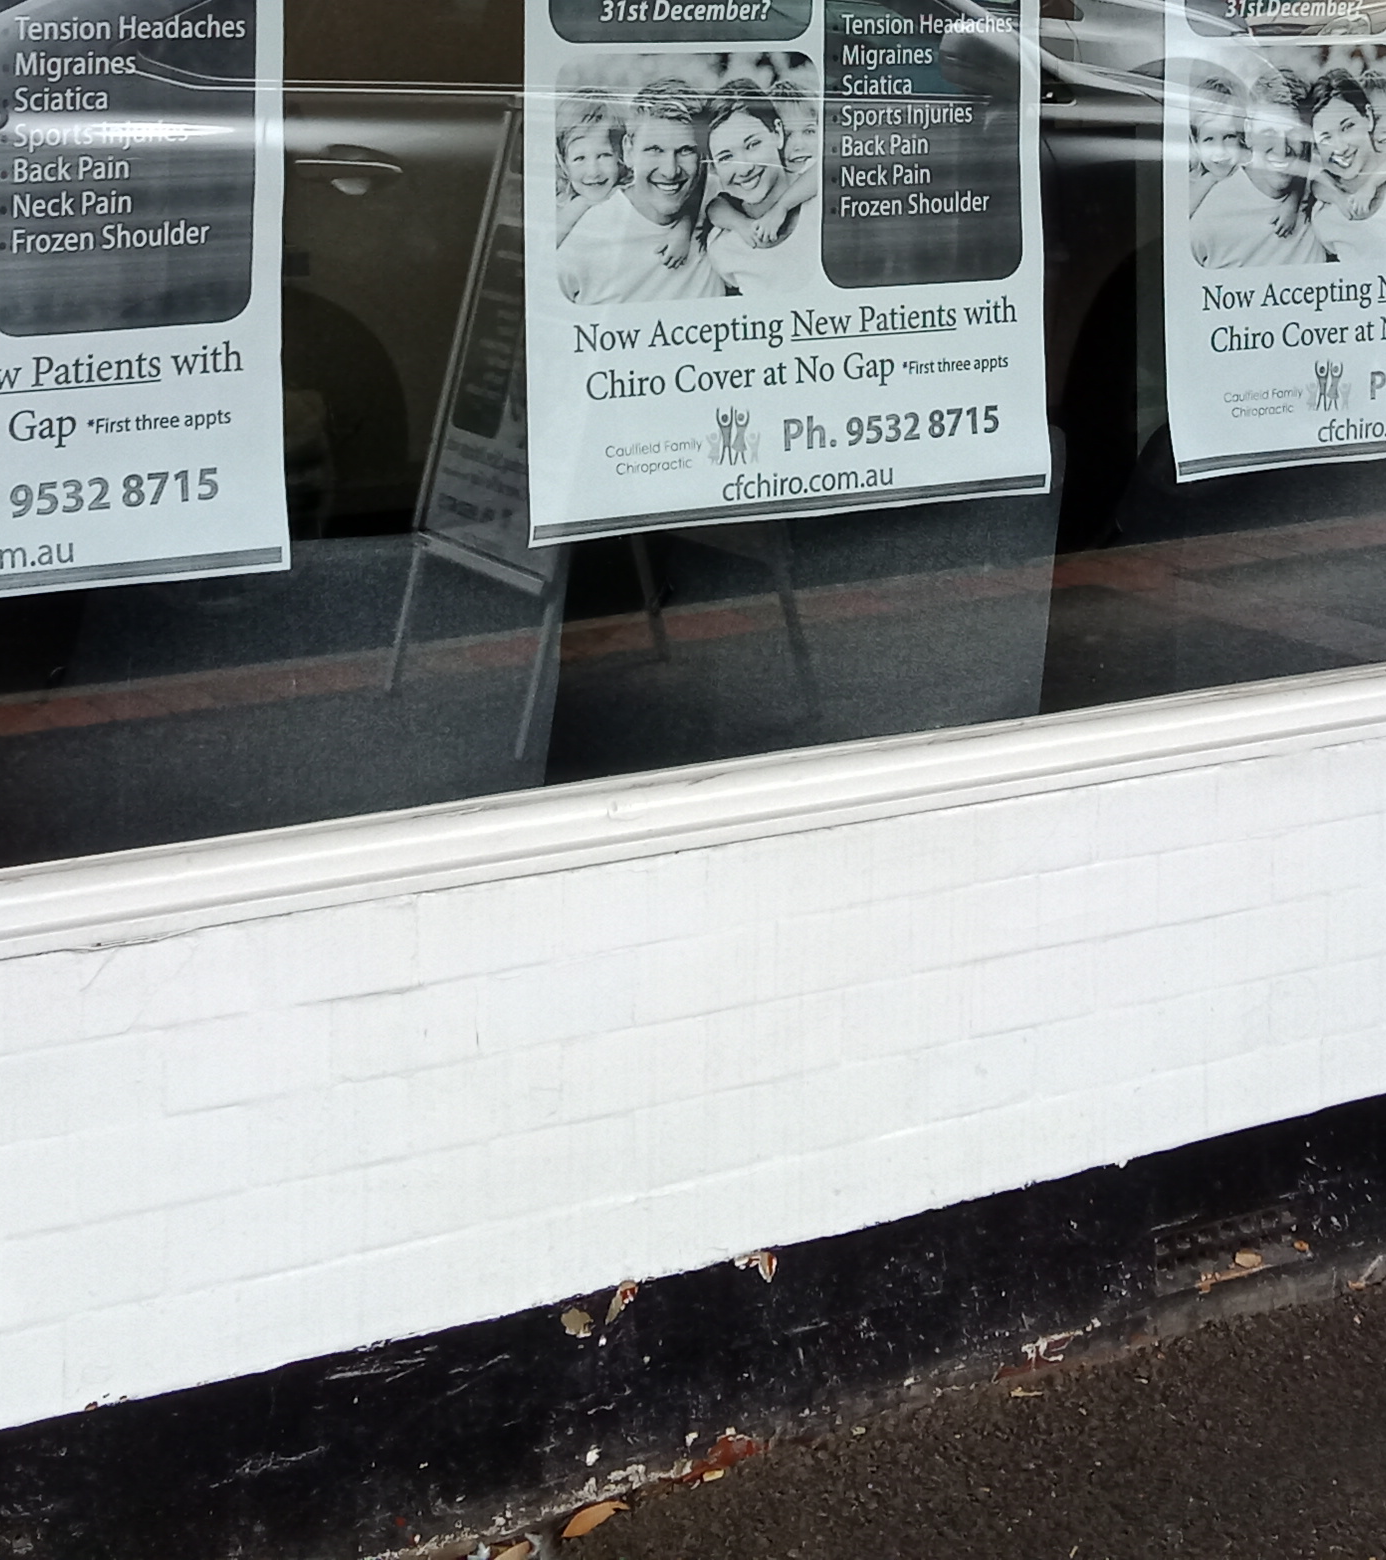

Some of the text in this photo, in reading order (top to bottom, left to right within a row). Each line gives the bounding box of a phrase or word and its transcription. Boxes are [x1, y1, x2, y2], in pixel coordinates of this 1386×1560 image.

[15, 15, 245, 42] Tension Headaches
[14, 51, 137, 81] Migraines
[842, 43, 933, 67] Migraines
[14, 85, 108, 112] Sciatica
[842, 74, 913, 94] Sciatica
[841, 104, 973, 128] Sports Injuries
[841, 135, 929, 156] Back Pain
[13, 156, 130, 182] Back Pain
[841, 165, 931, 187] Neck Pain
[13, 191, 132, 218] Neck Pain
[840, 192, 990, 217] Frozen Shoulder
[11, 221, 210, 254] Frozen Shoulder
[1202, 284, 1256, 311] Now
[1261, 279, 1372, 310] Accepting
[574, 296, 1017, 353] Now Accepting New Patients with
[1210, 327, 1275, 352] Chiro
[1282, 322, 1349, 347] Cover
[1355, 319, 1375, 343] at
[30, 349, 161, 390] Patients
[171, 341, 244, 378] with
[586, 370, 666, 400] Chiro
[674, 365, 755, 393] Cover
[763, 362, 787, 387] at
[794, 355, 835, 383] No
[843, 353, 895, 387] Gap
[937, 357, 971, 373] three
[973, 355, 1009, 373] appts
[8, 409, 77, 446] Gap
[135, 412, 179, 432] three
[184, 408, 232, 431] appts
[783, 405, 1000, 451] Ph. 9532 8715
[9, 474, 110, 516] 9532
[122, 466, 219, 509] 8715
[722, 465, 894, 502] cfchiro.com.au
